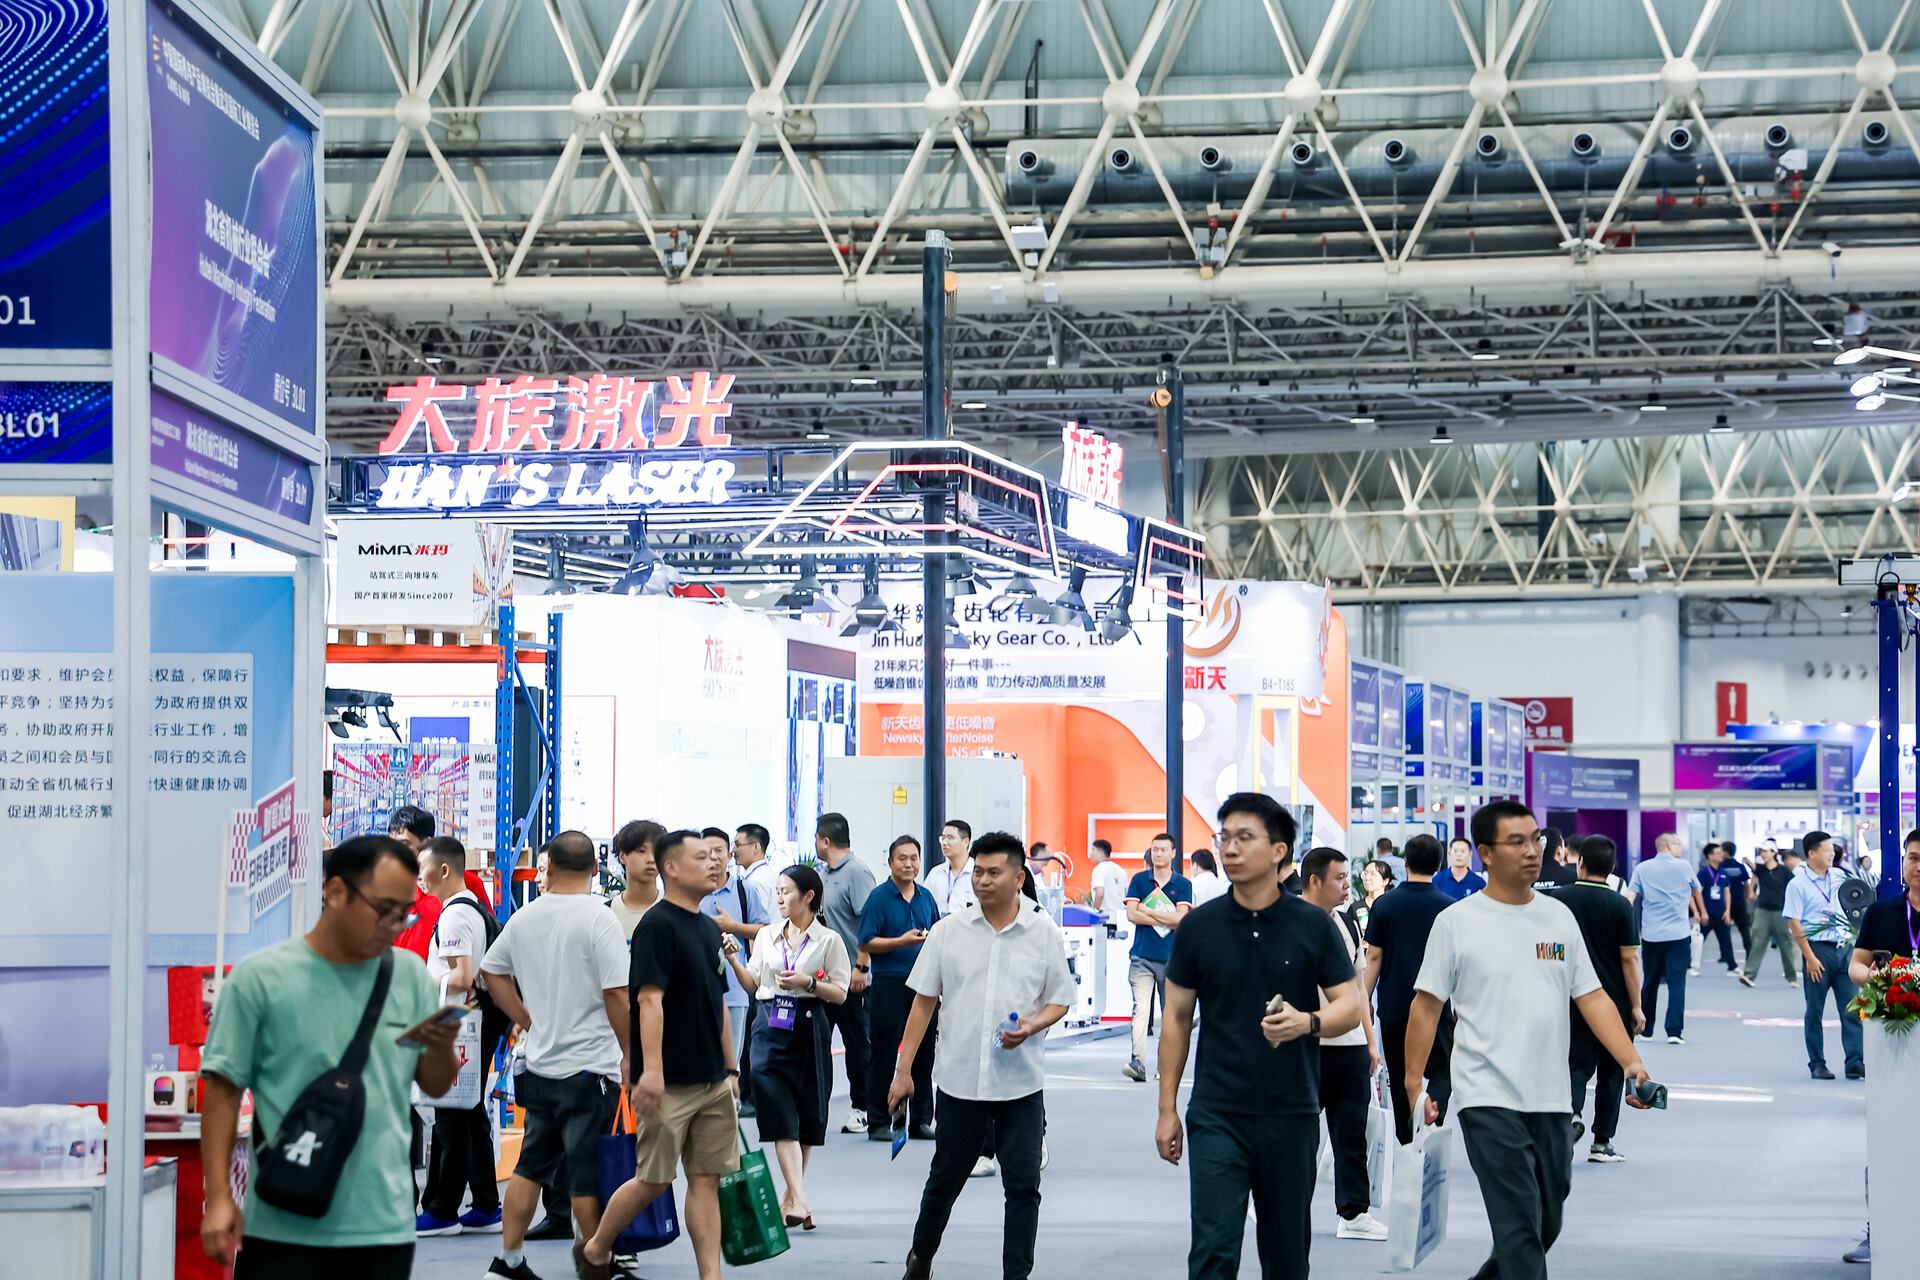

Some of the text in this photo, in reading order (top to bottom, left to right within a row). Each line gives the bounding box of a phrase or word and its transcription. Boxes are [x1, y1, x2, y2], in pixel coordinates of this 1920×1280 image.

[291, 384, 307, 413] 3L01
[378, 371, 736, 456] 大族激光
[557, 458, 736, 507] LASER
[872, 633, 889, 648] Jin
[996, 630, 1038, 646] Gear
[987, 675, 1106, 689] 助力传动高质量发展
[1184, 666, 1227, 691] 新天
